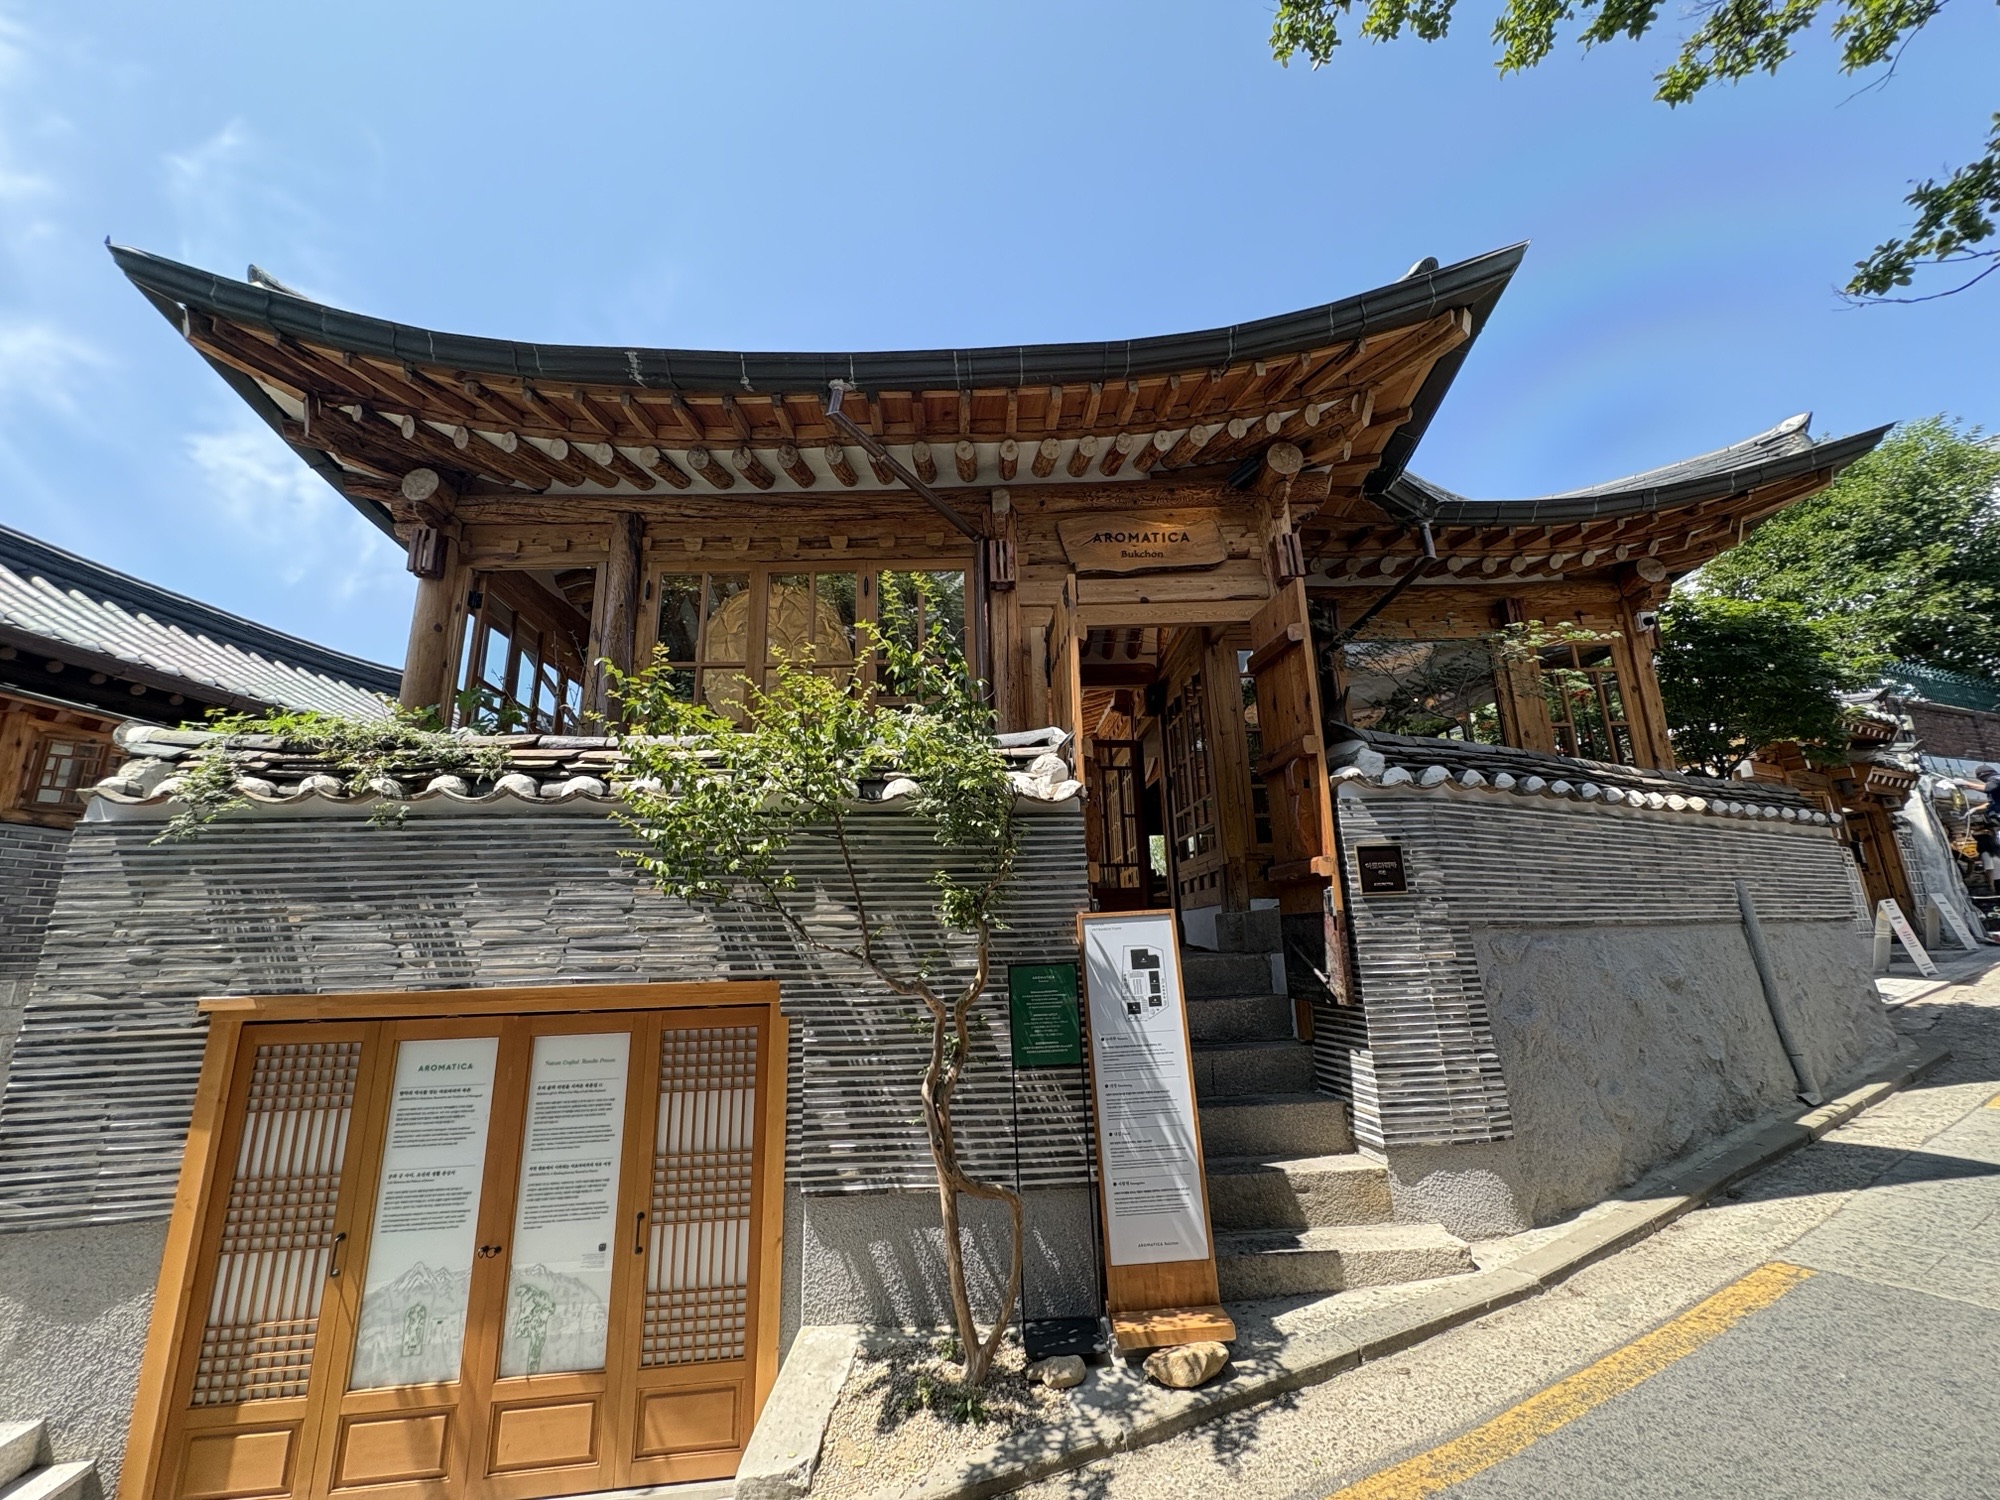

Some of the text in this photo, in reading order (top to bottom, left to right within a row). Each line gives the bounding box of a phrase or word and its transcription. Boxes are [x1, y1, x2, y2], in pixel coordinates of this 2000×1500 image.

[1092, 531, 1190, 543] AROMATICA
[1121, 550, 1164, 558] Bukchon
[418, 1063, 474, 1072] AROMATICA
